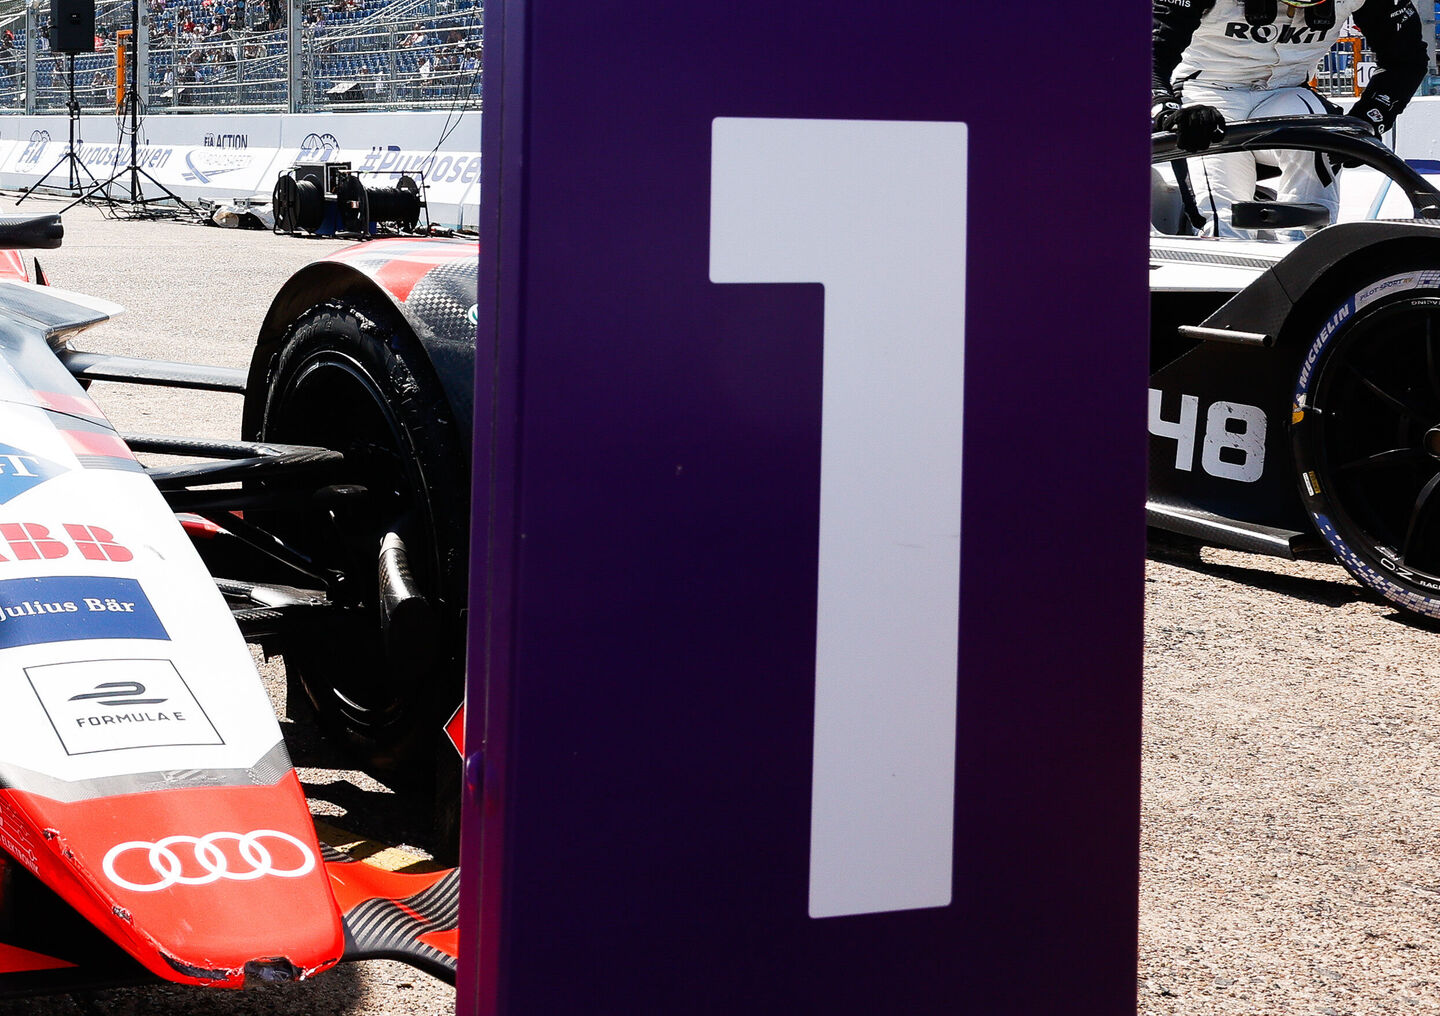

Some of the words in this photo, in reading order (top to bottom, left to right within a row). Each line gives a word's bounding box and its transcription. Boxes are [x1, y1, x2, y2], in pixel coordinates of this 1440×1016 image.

[216, 134, 249, 150] ACTION
[1298, 303, 1350, 390] MICHELIN
[1148, 387, 1268, 484] 48
[709, 116, 969, 920] 1
[87, 596, 136, 616] Bär
[75, 711, 171, 729] FORMULA
[172, 710, 186, 721] E
